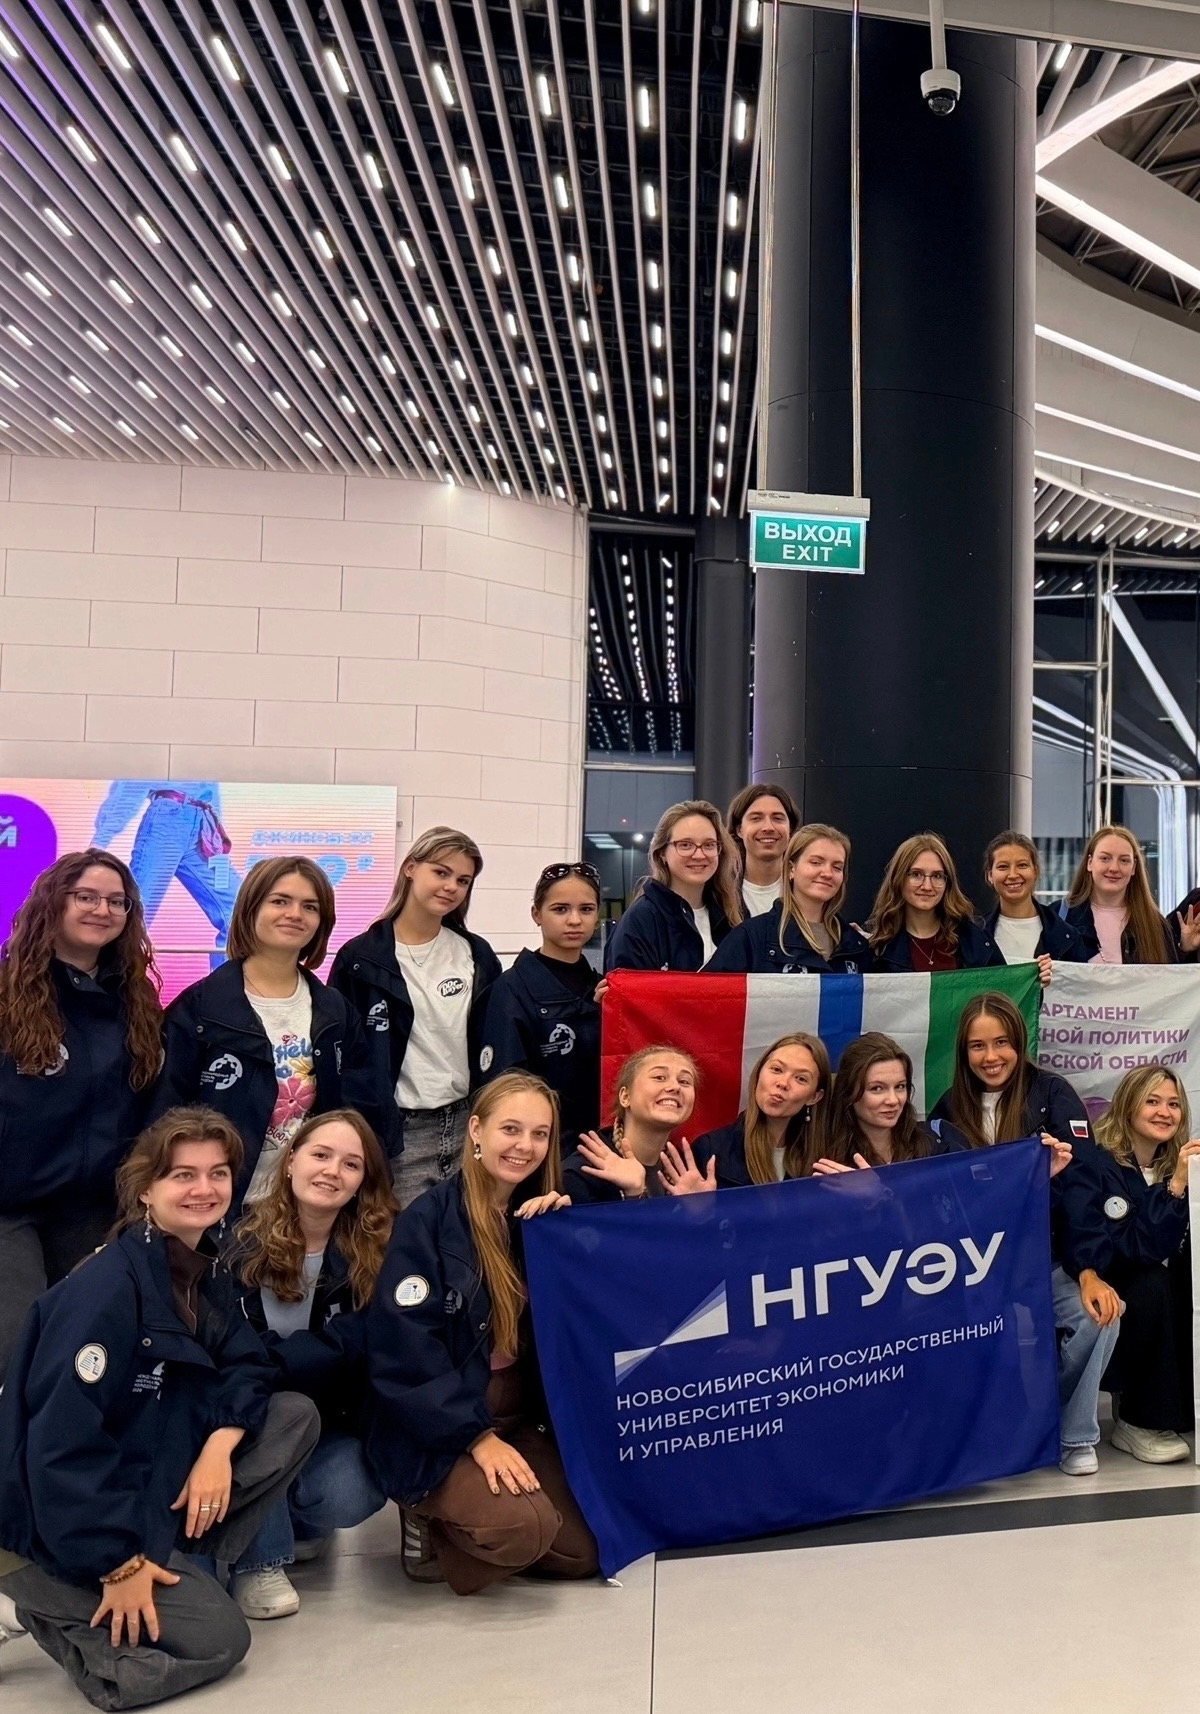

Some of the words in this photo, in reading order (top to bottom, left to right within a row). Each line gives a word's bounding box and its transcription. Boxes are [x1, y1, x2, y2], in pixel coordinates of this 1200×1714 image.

[764, 521, 852, 547] ВЫХОД
[782, 544, 833, 562] EXIT
[1088, 1028, 1190, 1046] ПОЛИТИКИ
[1108, 1050, 1188, 1070] ОБЛАСТИ
[751, 1231, 1005, 1328] НГУЭУ
[616, 1357, 814, 1411] НОВОСИБИРСКИЙ
[818, 1315, 1004, 1373] ГОСУДАРСТВЕННЫЙ
[617, 1395, 772, 1437] УНИВЕРСИТЕТ
[776, 1364, 905, 1408] ЭКОНОМИКИ
[618, 1446, 635, 1462] И
[640, 1418, 784, 1460] УПРАВЛЕНИЯ
